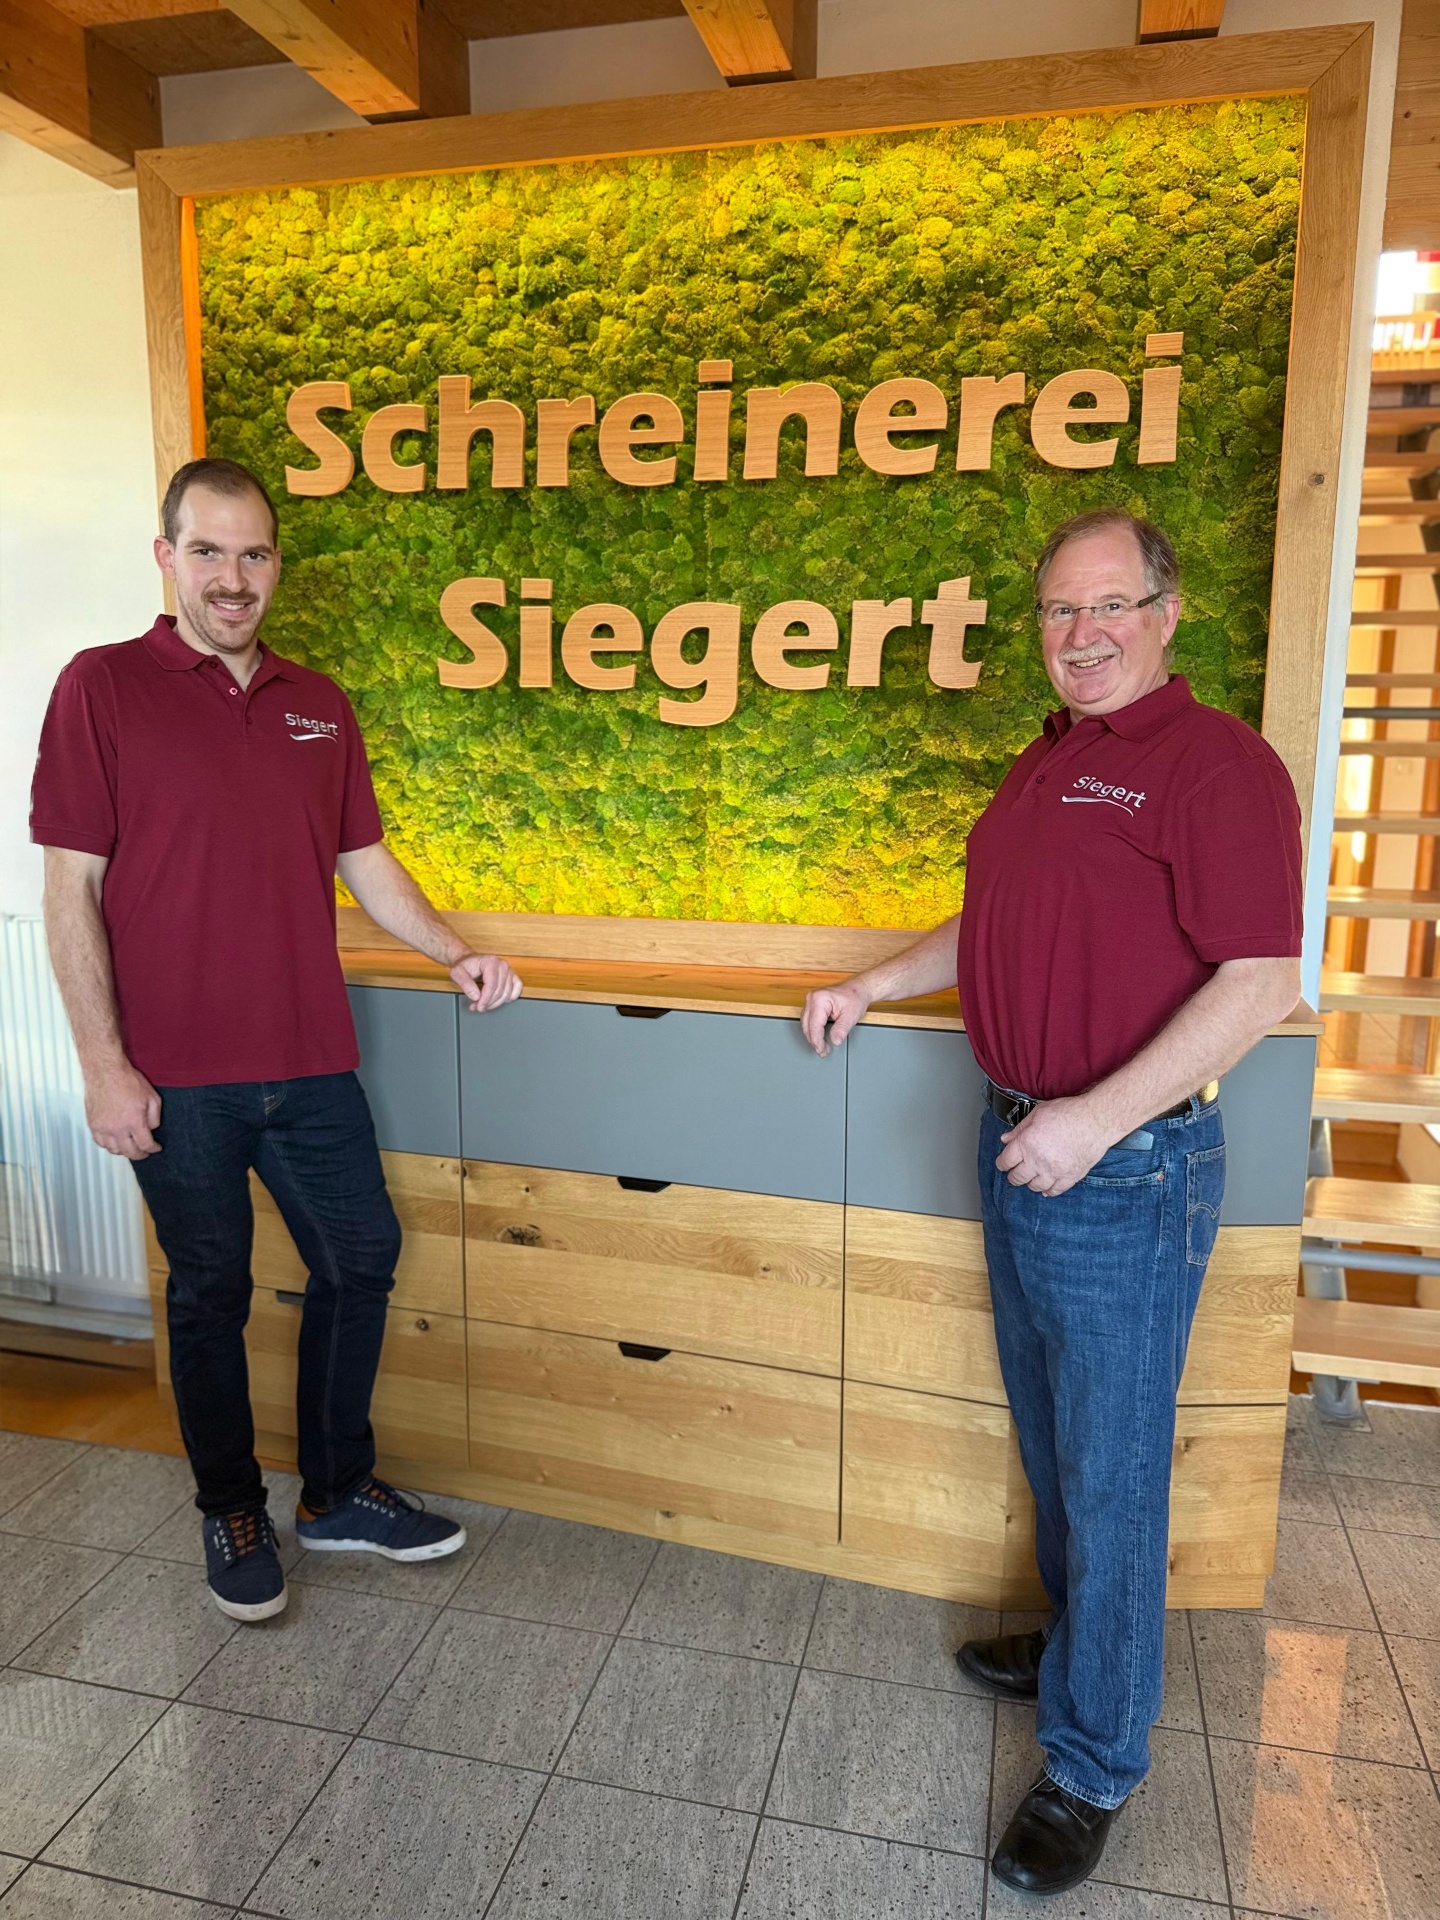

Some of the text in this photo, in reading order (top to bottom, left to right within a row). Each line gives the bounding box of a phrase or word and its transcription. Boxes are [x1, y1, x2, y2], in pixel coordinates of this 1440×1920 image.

[284, 331, 1185, 496] Schreinerei
[437, 577, 988, 727] Siegert
[285, 713, 338, 735] Siegert
[1073, 776, 1146, 808] Siegert
